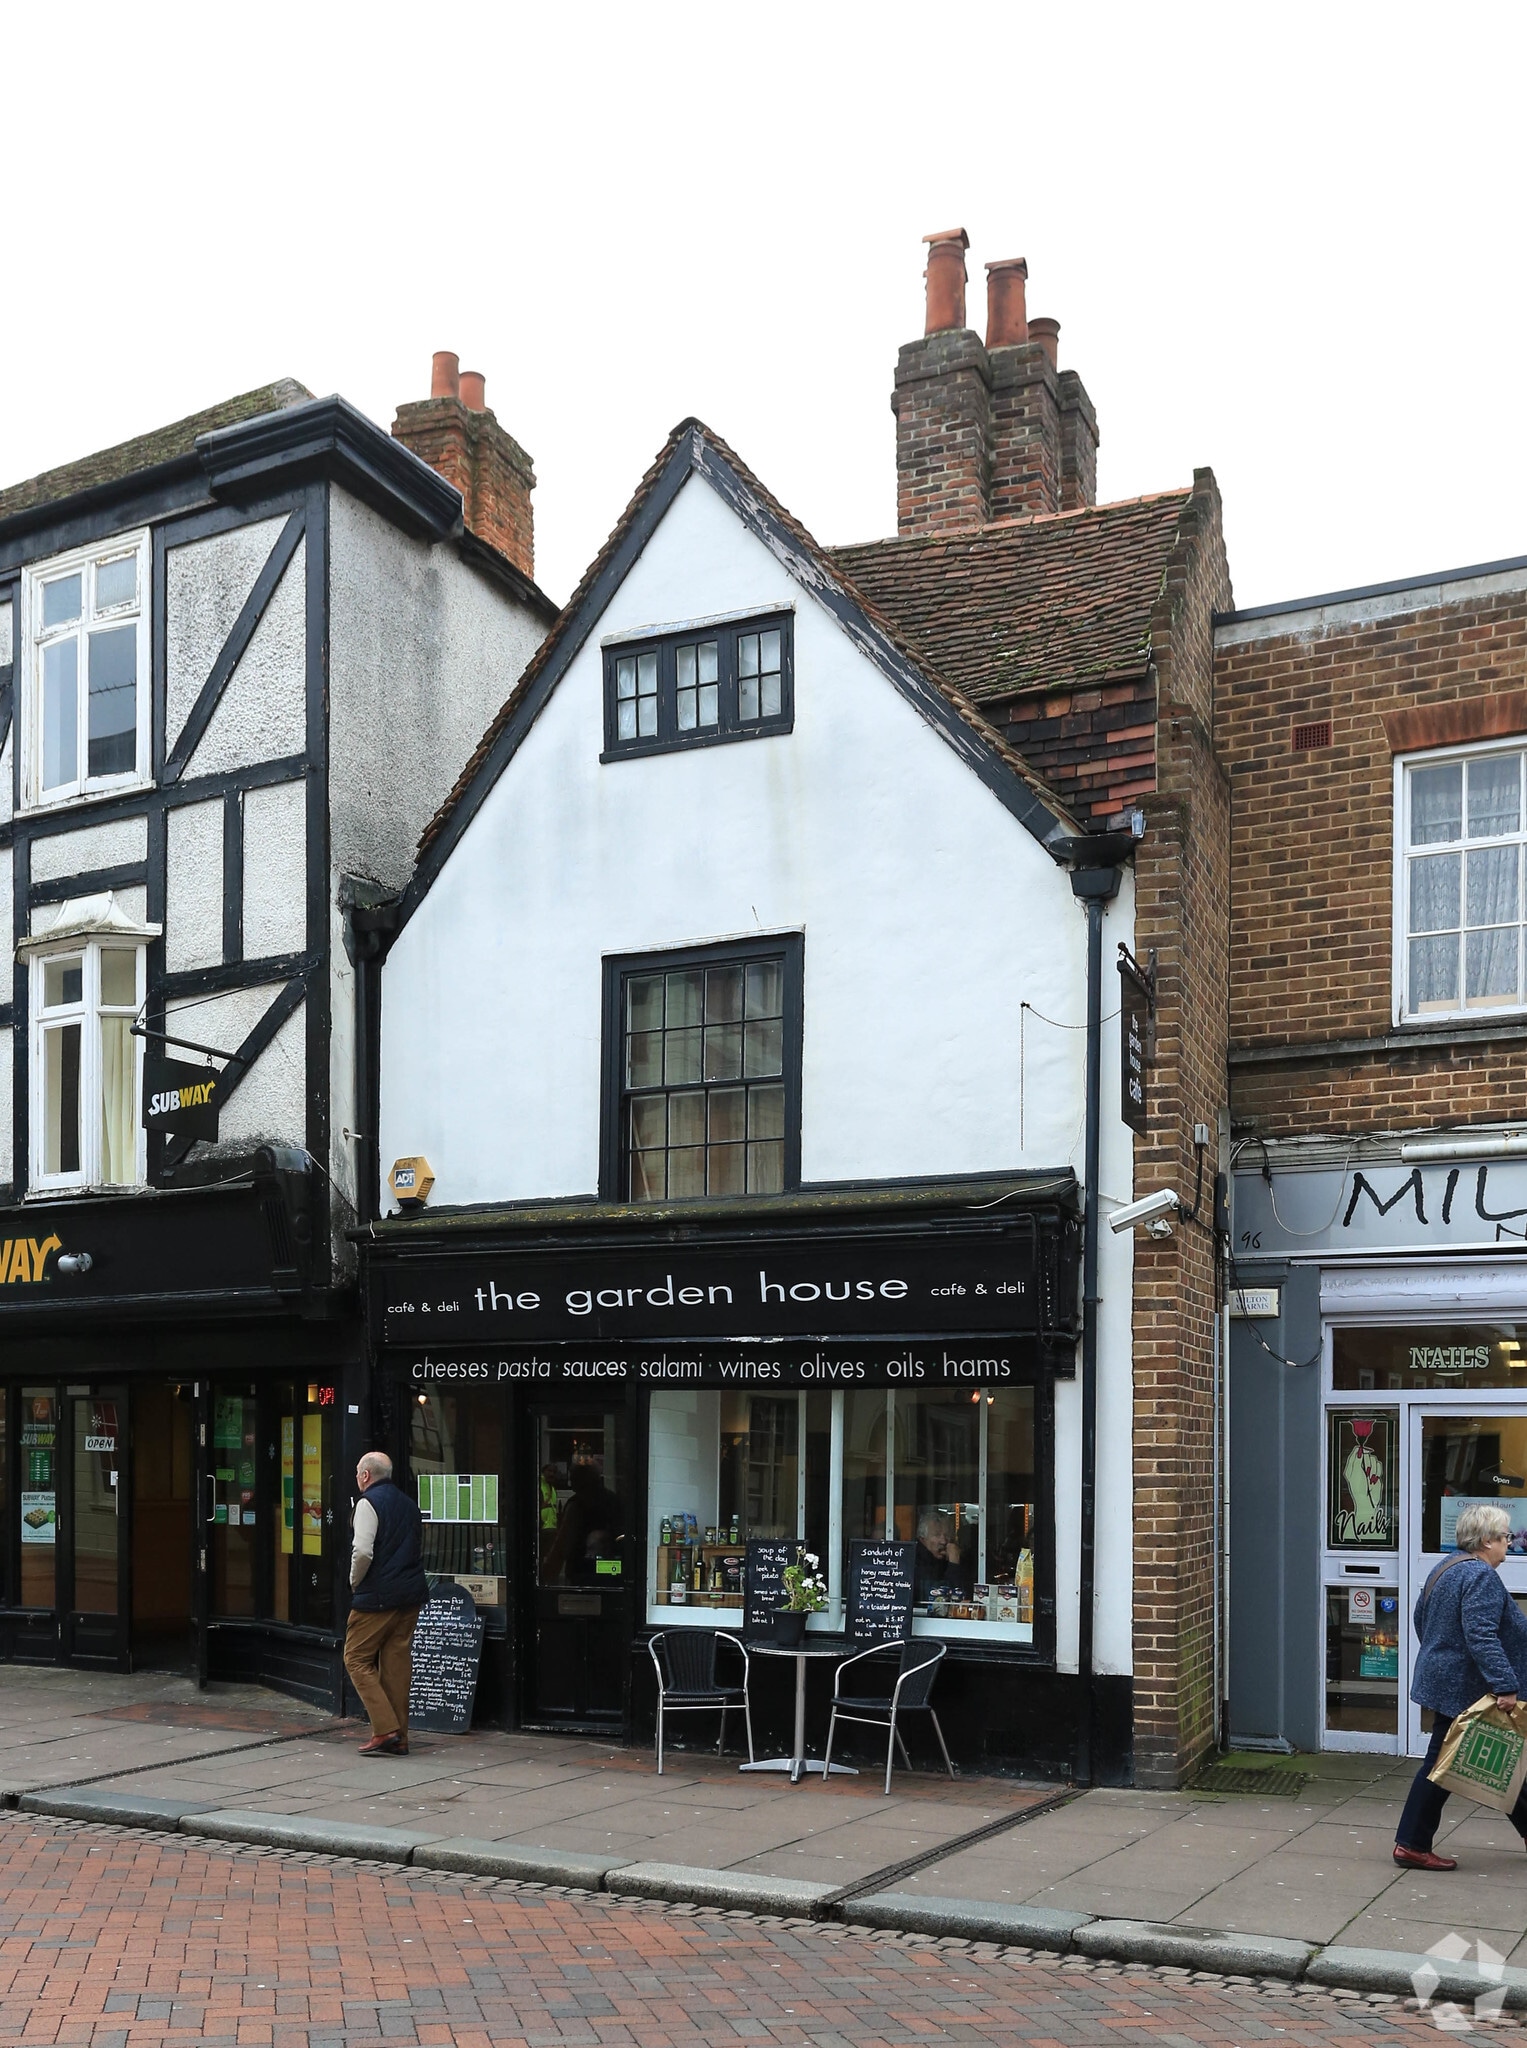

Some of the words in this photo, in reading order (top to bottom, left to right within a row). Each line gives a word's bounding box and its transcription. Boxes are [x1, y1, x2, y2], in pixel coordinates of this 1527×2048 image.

[1128, 1032, 1142, 1054] garden
[1129, 1049, 1141, 1074] house
[148, 1080, 216, 1116] SUBWAY
[396, 1173, 414, 1184] ADT
[1241, 1231, 1262, 1249] 96
[421, 1302, 432, 1312] &
[437, 1300, 460, 1312] deli
[474, 1280, 540, 1311] the
[565, 1274, 733, 1315] garden
[760, 1270, 908, 1302] house
[974, 1284, 988, 1296] &
[996, 1282, 1026, 1294] deli
[1409, 1346, 1490, 1368] NAILS
[412, 1356, 488, 1378] cheeses
[497, 1356, 550, 1380] pasta
[562, 1359, 627, 1378] sauces
[640, 1354, 703, 1378] salami
[718, 1353, 781, 1378] wines
[800, 1352, 865, 1378] olives
[886, 1352, 925, 1378] oils
[943, 1352, 1010, 1378] hams
[20, 1432, 56, 1445] SUBWAY
[88, 1438, 113, 1448] OPEN
[1492, 1475, 1510, 1484] Open
[1336, 1508, 1388, 1542] Nails
[894, 1548, 904, 1556] of
[775, 1554, 788, 1566] day
[872, 1558, 885, 1566] the
[886, 1558, 898, 1570] day
[762, 1573, 779, 1581] potato
[860, 1568, 876, 1580] honey
